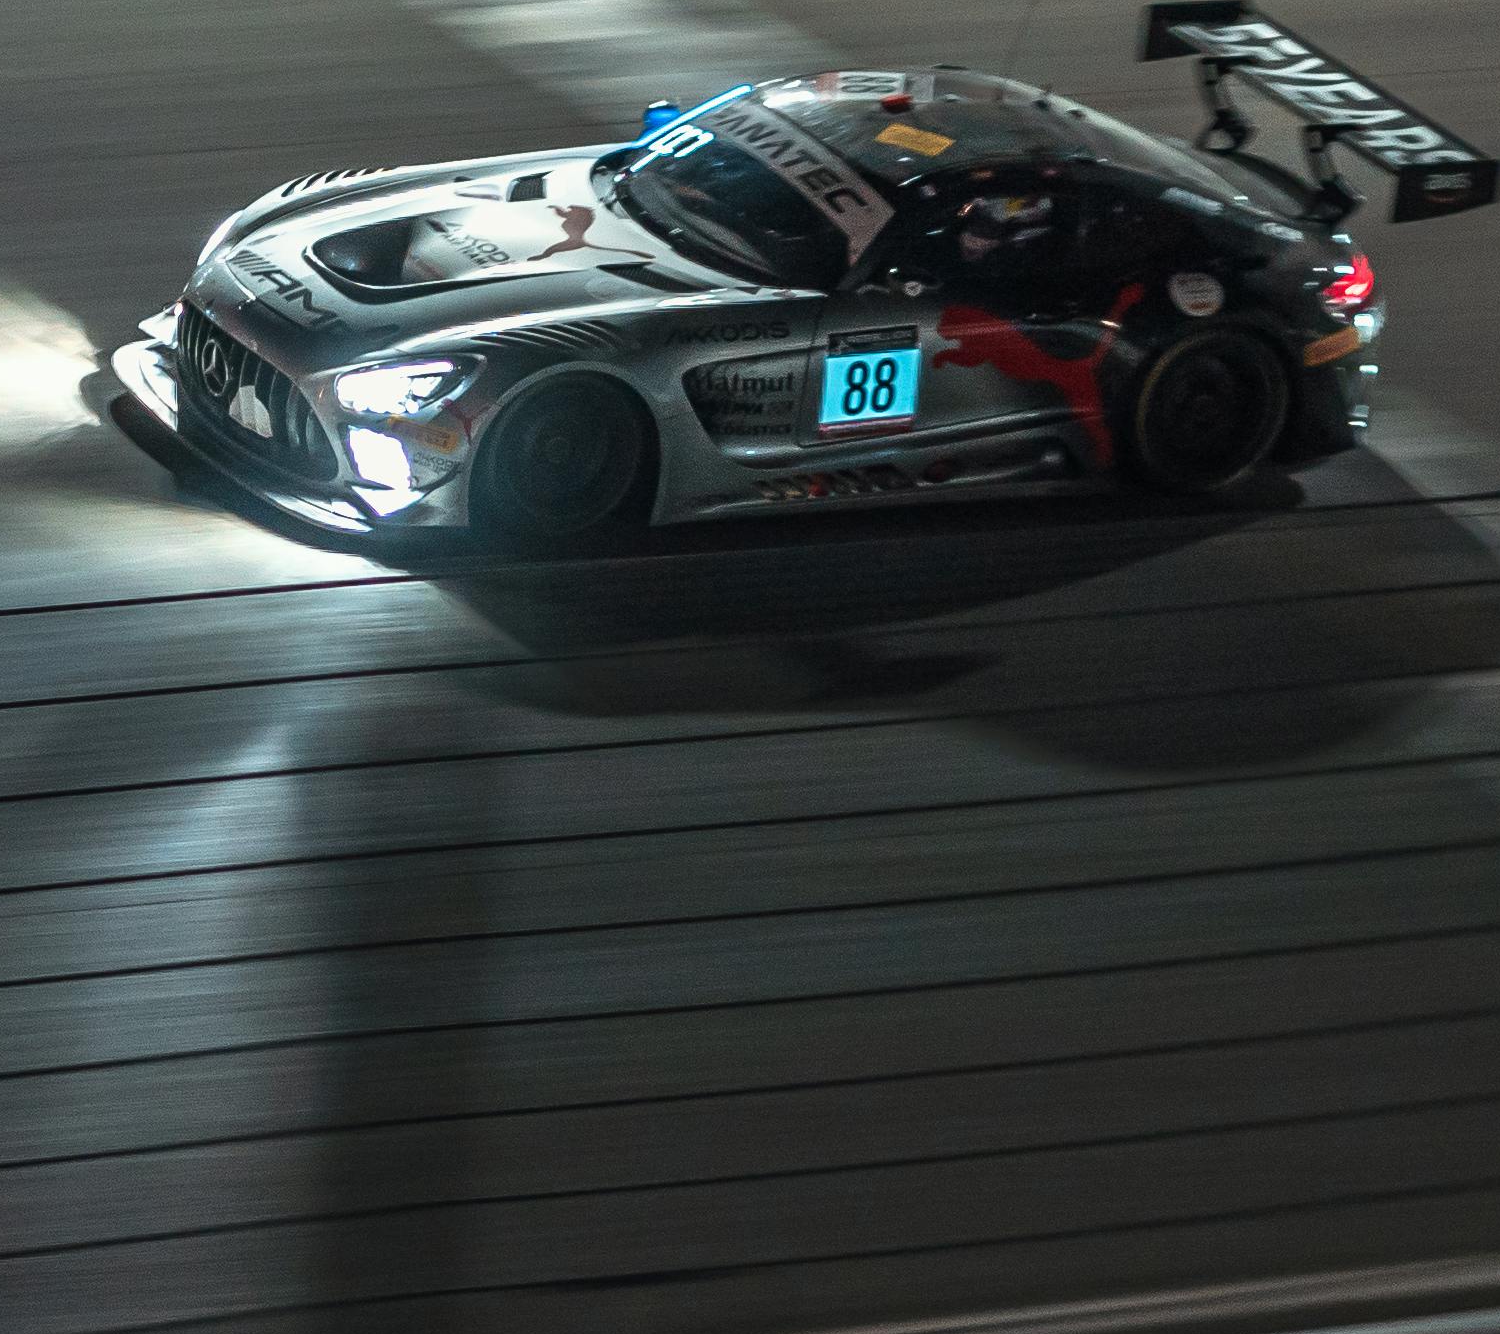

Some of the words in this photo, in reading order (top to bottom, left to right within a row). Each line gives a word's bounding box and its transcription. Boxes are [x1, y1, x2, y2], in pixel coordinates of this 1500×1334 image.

[841, 75, 897, 94] 88
[249, 267, 348, 331] AM
[842, 357, 898, 415] 88
